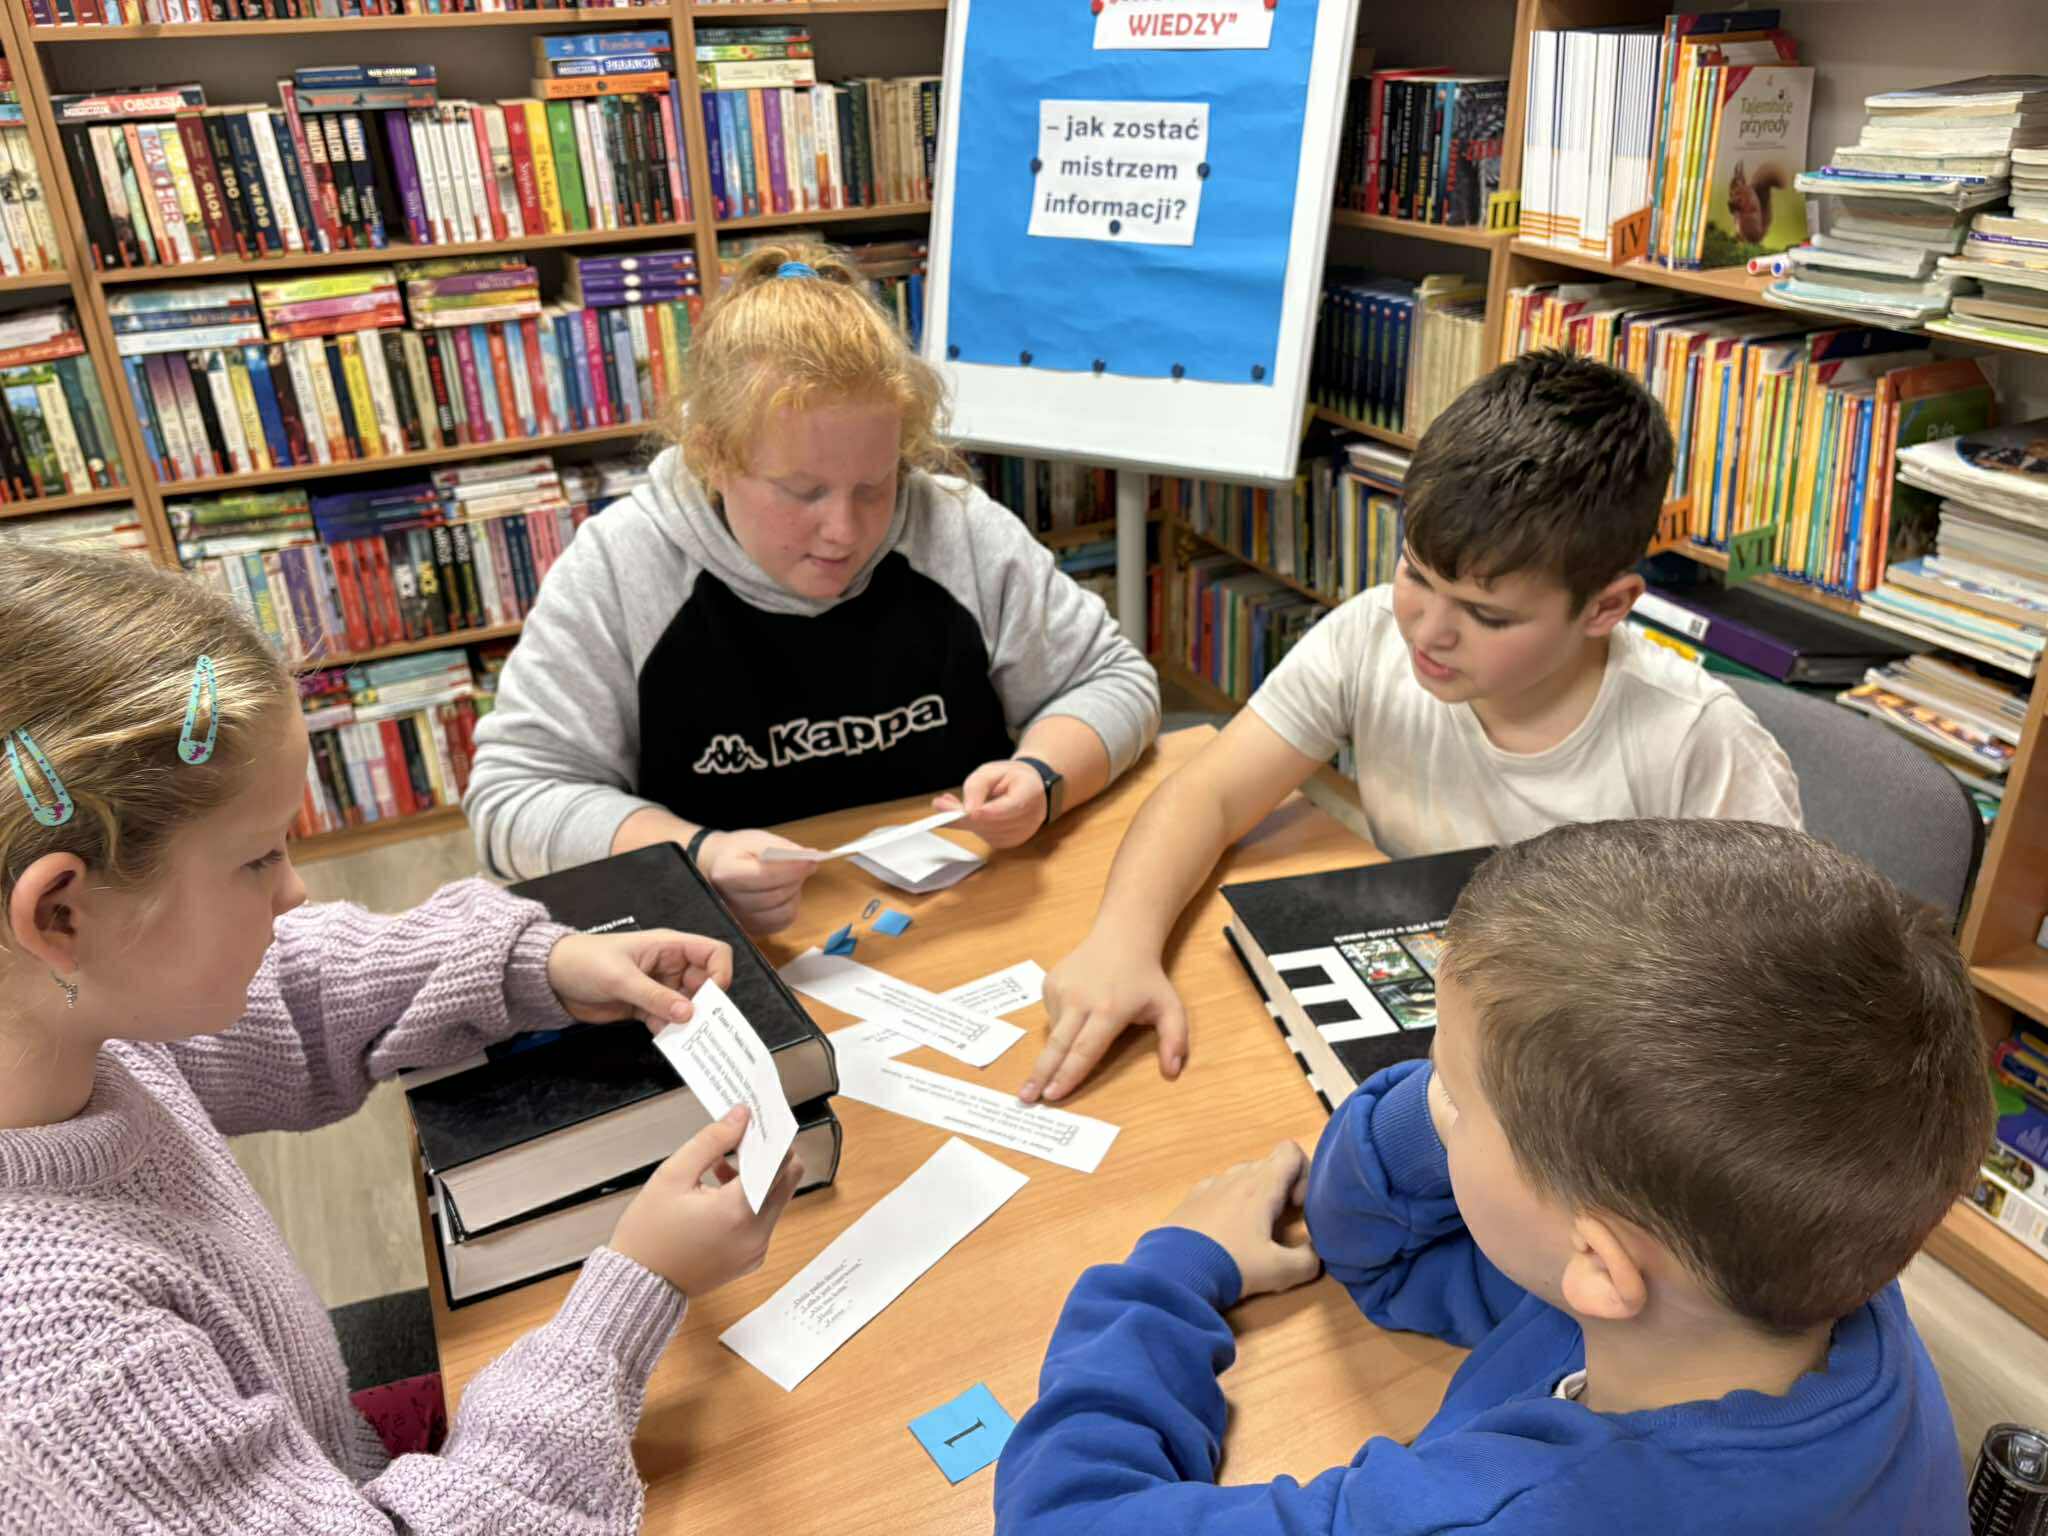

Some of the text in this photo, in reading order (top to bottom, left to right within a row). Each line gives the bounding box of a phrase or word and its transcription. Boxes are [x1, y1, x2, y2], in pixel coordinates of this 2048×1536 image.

[1064, 114, 1104, 142] jak
[1112, 118, 1200, 141] zostać
[1738, 115, 1789, 138] przyrody
[1060, 155, 1178, 180] mistrzem
[1044, 192, 1187, 224] informacji?
[1620, 216, 1646, 257] IV
[769, 695, 948, 767] Kappa
